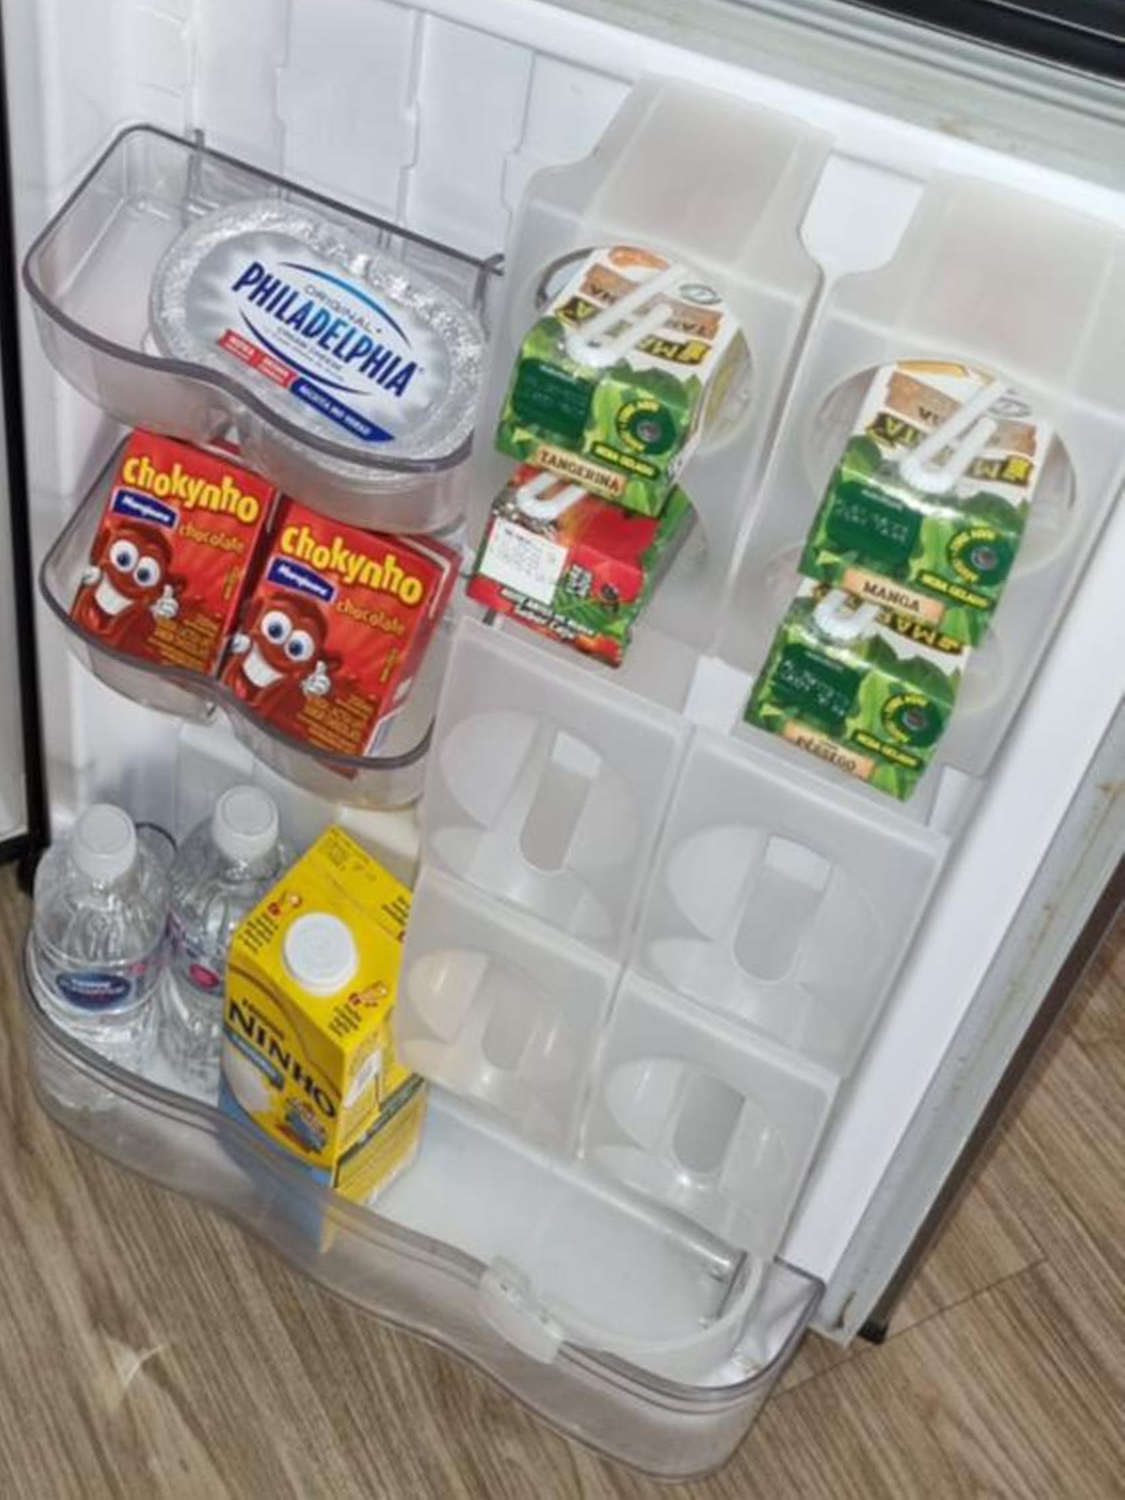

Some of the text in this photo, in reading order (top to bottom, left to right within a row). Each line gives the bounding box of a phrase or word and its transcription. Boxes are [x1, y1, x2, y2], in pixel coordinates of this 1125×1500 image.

[231, 261, 419, 398] PHILADELPHIA
[122, 456, 259, 524] chokynho
[539, 449, 622, 494] TANGERINA
[177, 523, 245, 555] chocolate
[280, 525, 424, 605] chokynho
[335, 598, 407, 636] chocolate
[862, 580, 921, 613] MANGA
[228, 999, 337, 1119] NINHO
